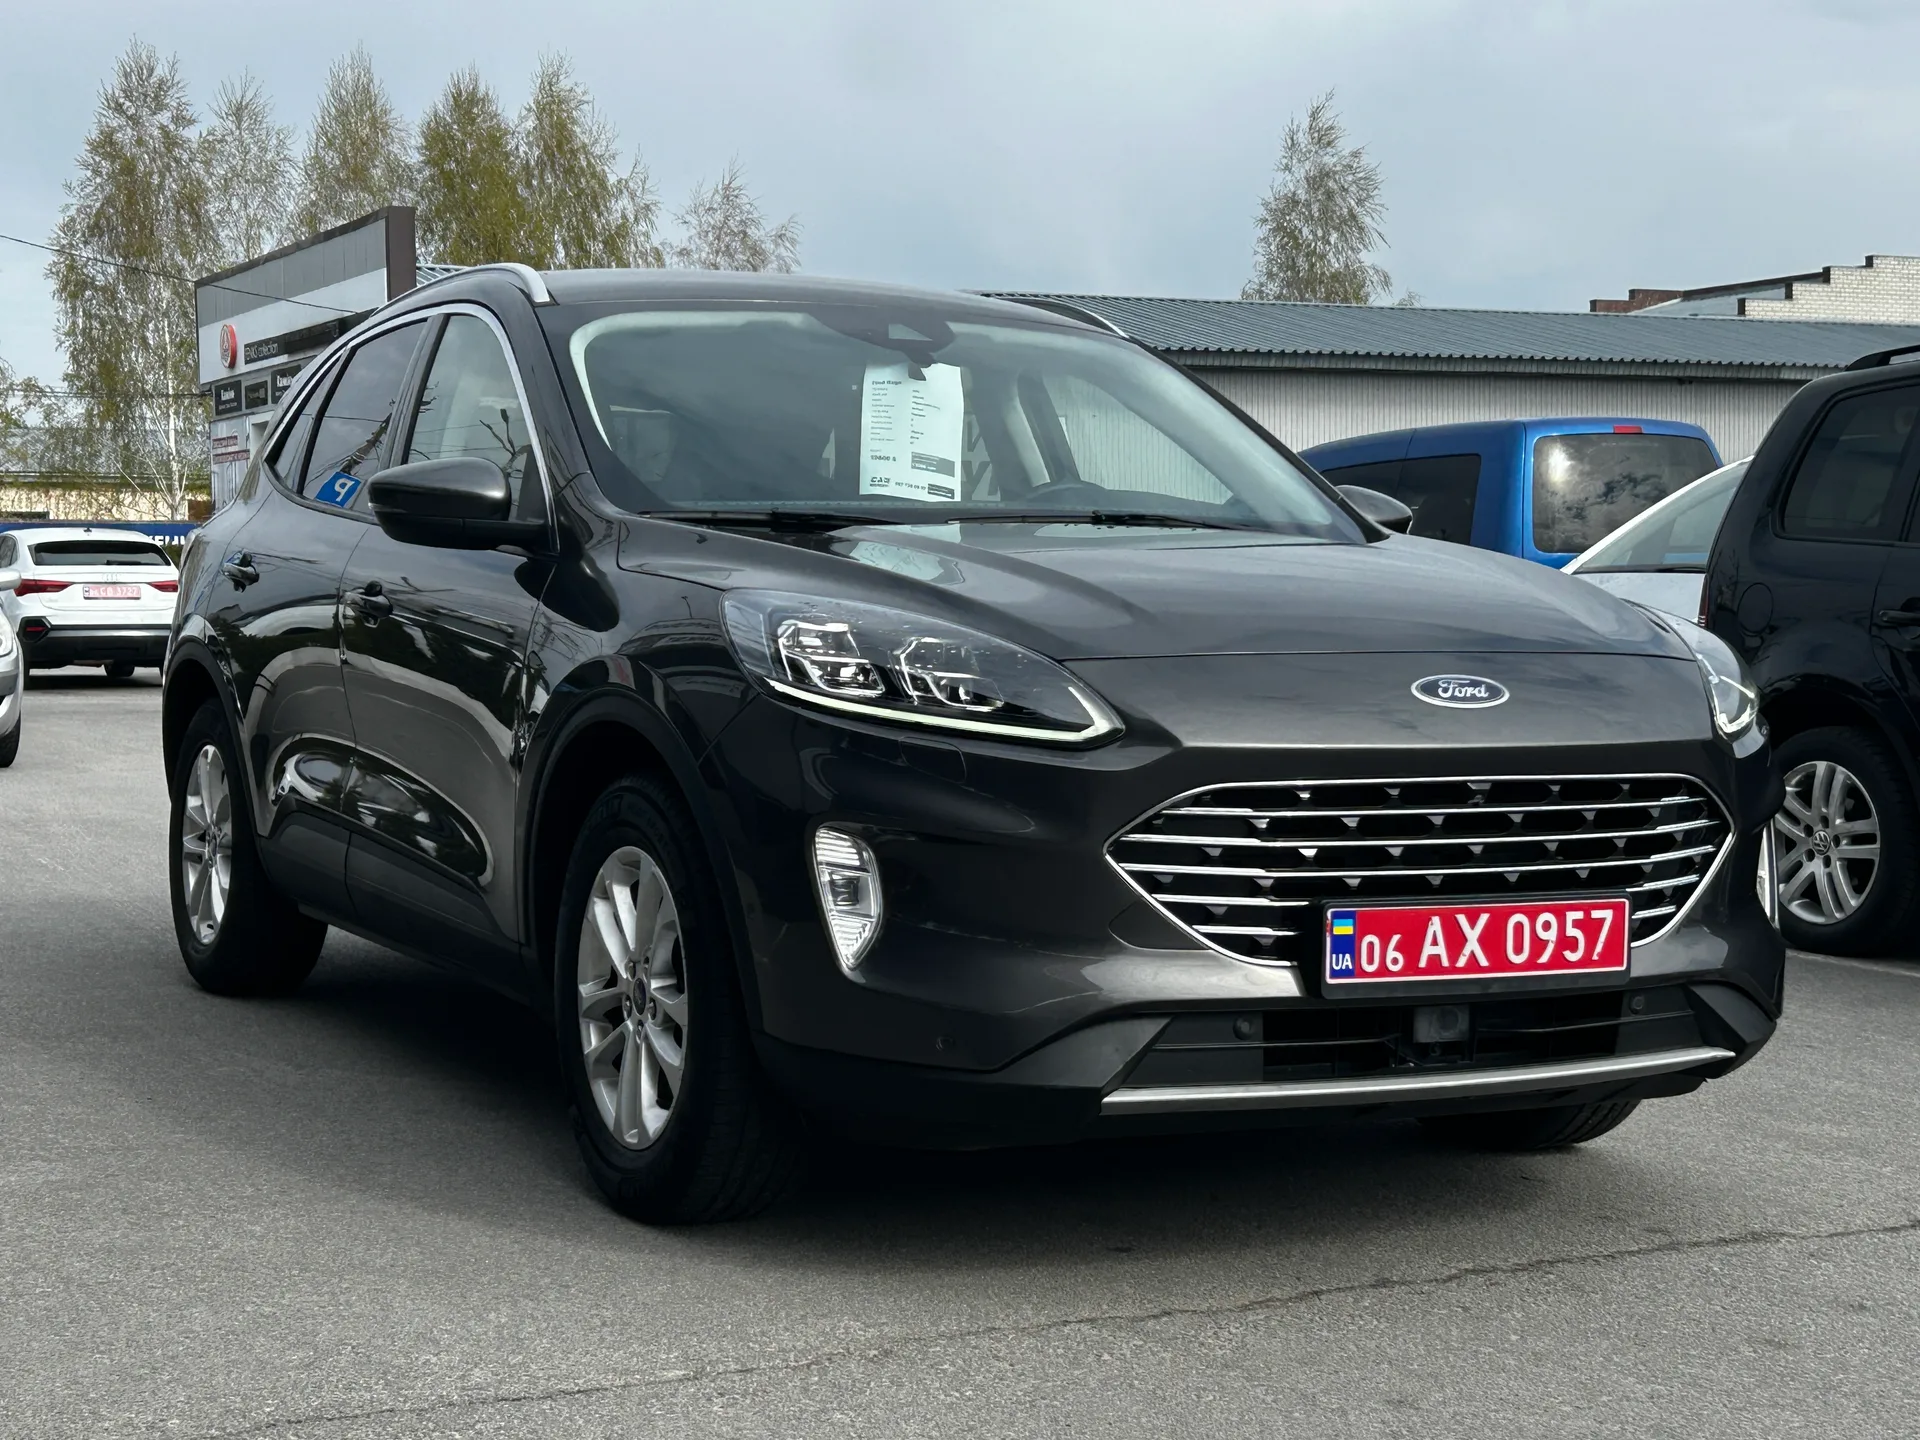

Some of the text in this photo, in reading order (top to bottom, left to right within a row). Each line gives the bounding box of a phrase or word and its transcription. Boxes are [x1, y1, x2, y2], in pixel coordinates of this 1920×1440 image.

[1437, 679, 1490, 698] Ford
[1360, 909, 1614, 973] 06 AX 0957
[1332, 953, 1353, 970] UA
